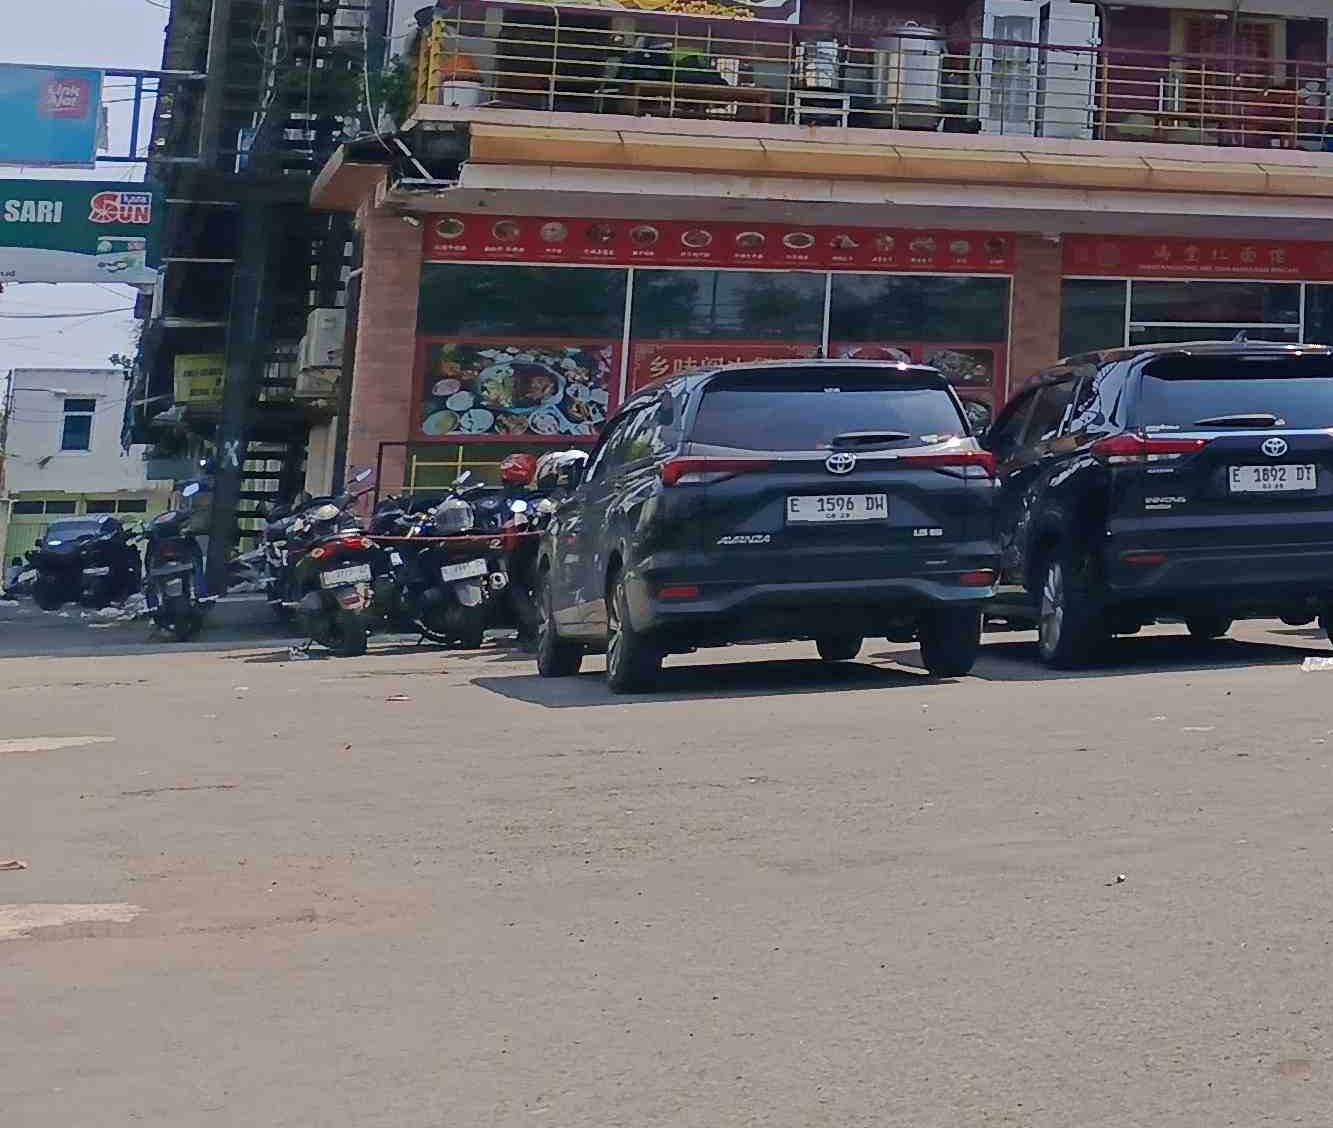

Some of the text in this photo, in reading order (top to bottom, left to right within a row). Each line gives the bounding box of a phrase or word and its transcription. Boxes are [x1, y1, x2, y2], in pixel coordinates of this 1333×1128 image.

[4, 199, 63, 223] SARI
[1232, 468, 1241, 483] E
[790, 495, 884, 513] E 1596 DW
